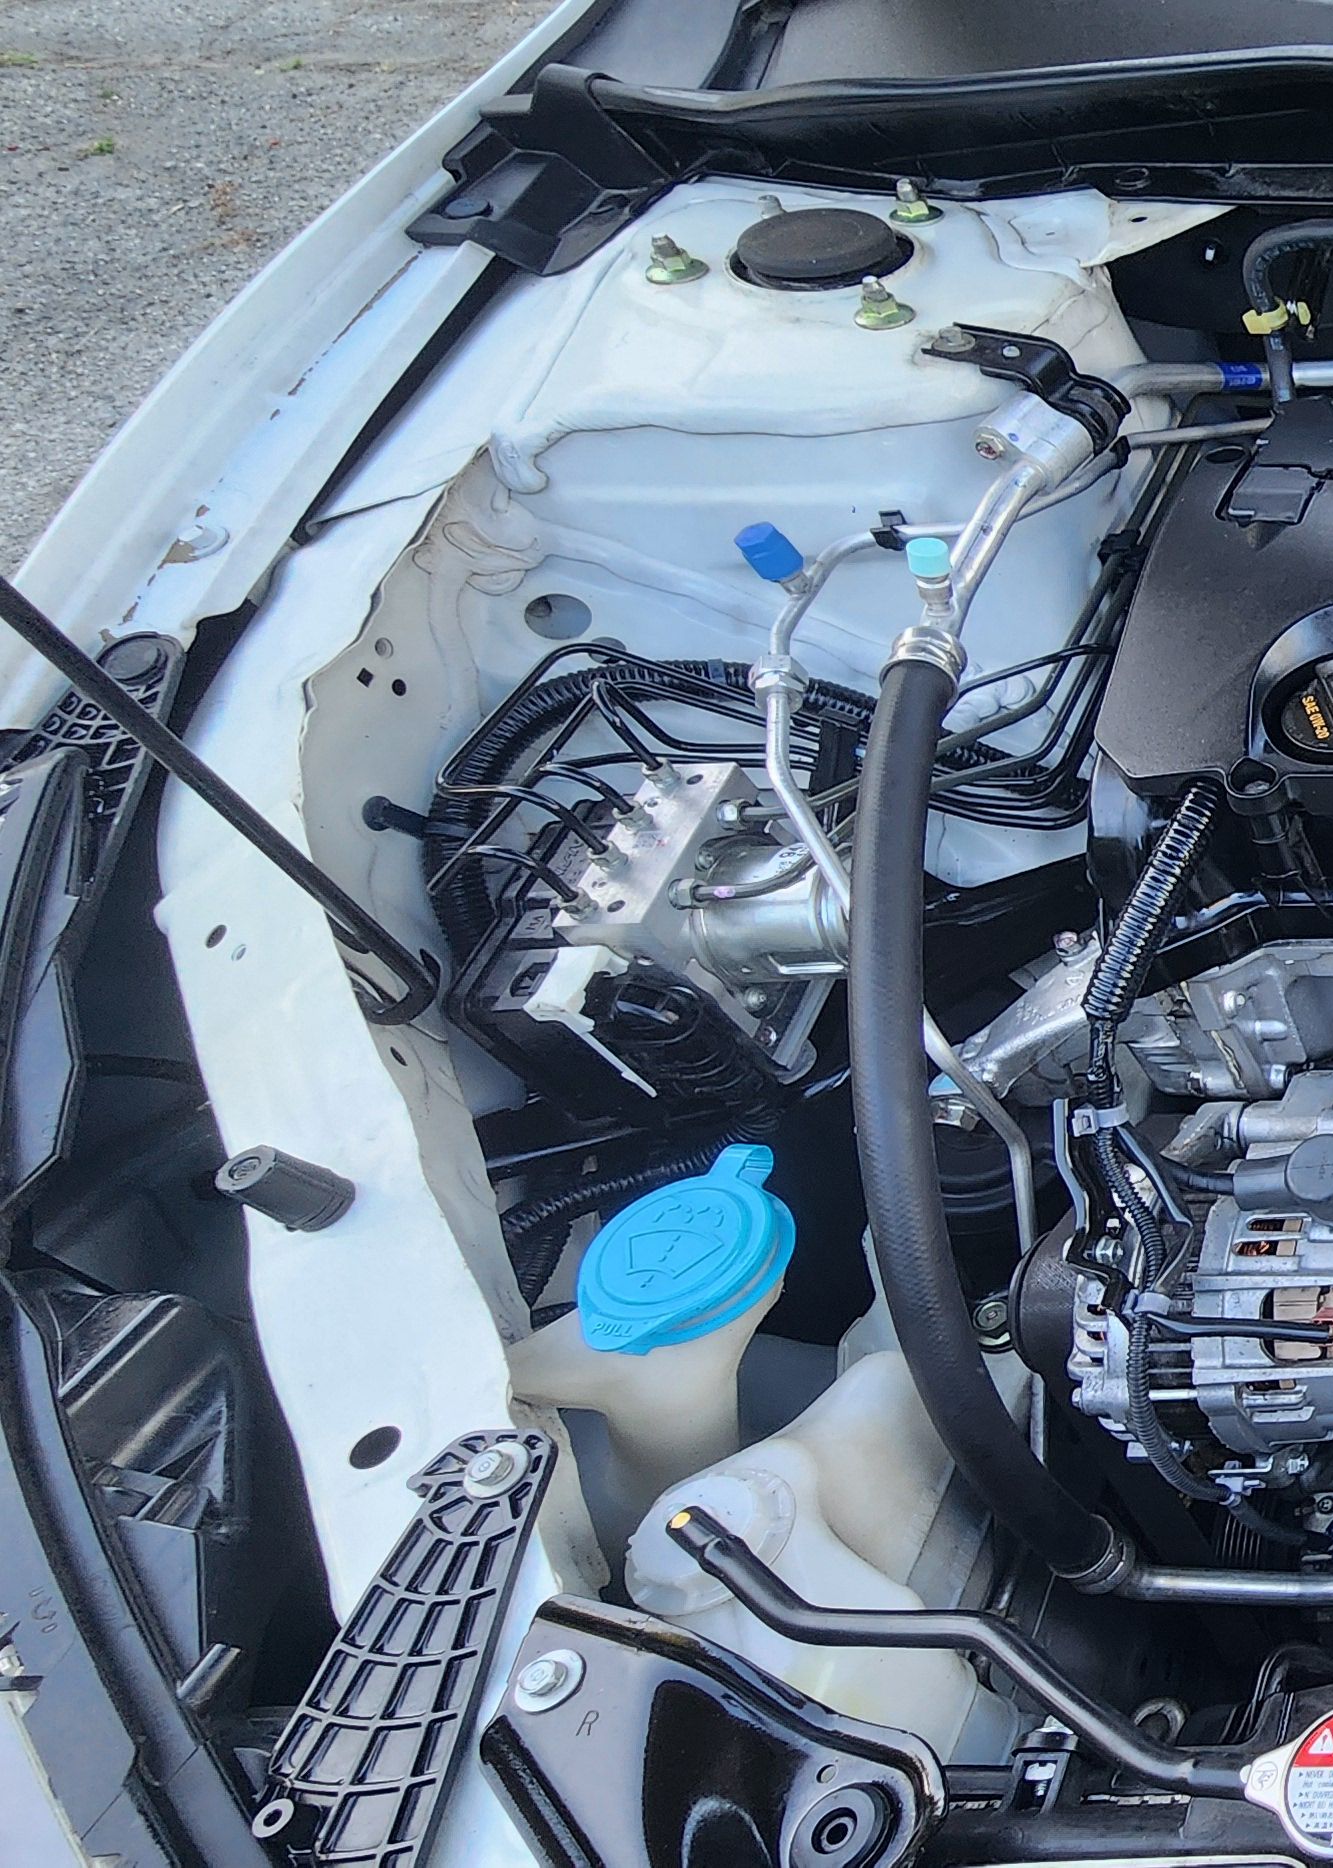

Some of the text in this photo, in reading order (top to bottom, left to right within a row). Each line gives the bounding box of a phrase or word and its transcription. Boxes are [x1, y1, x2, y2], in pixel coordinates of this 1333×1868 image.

[1302, 695, 1330, 739] SAE 0W-20
[590, 1323, 633, 1337] PULL
[576, 1710, 600, 1736] R
